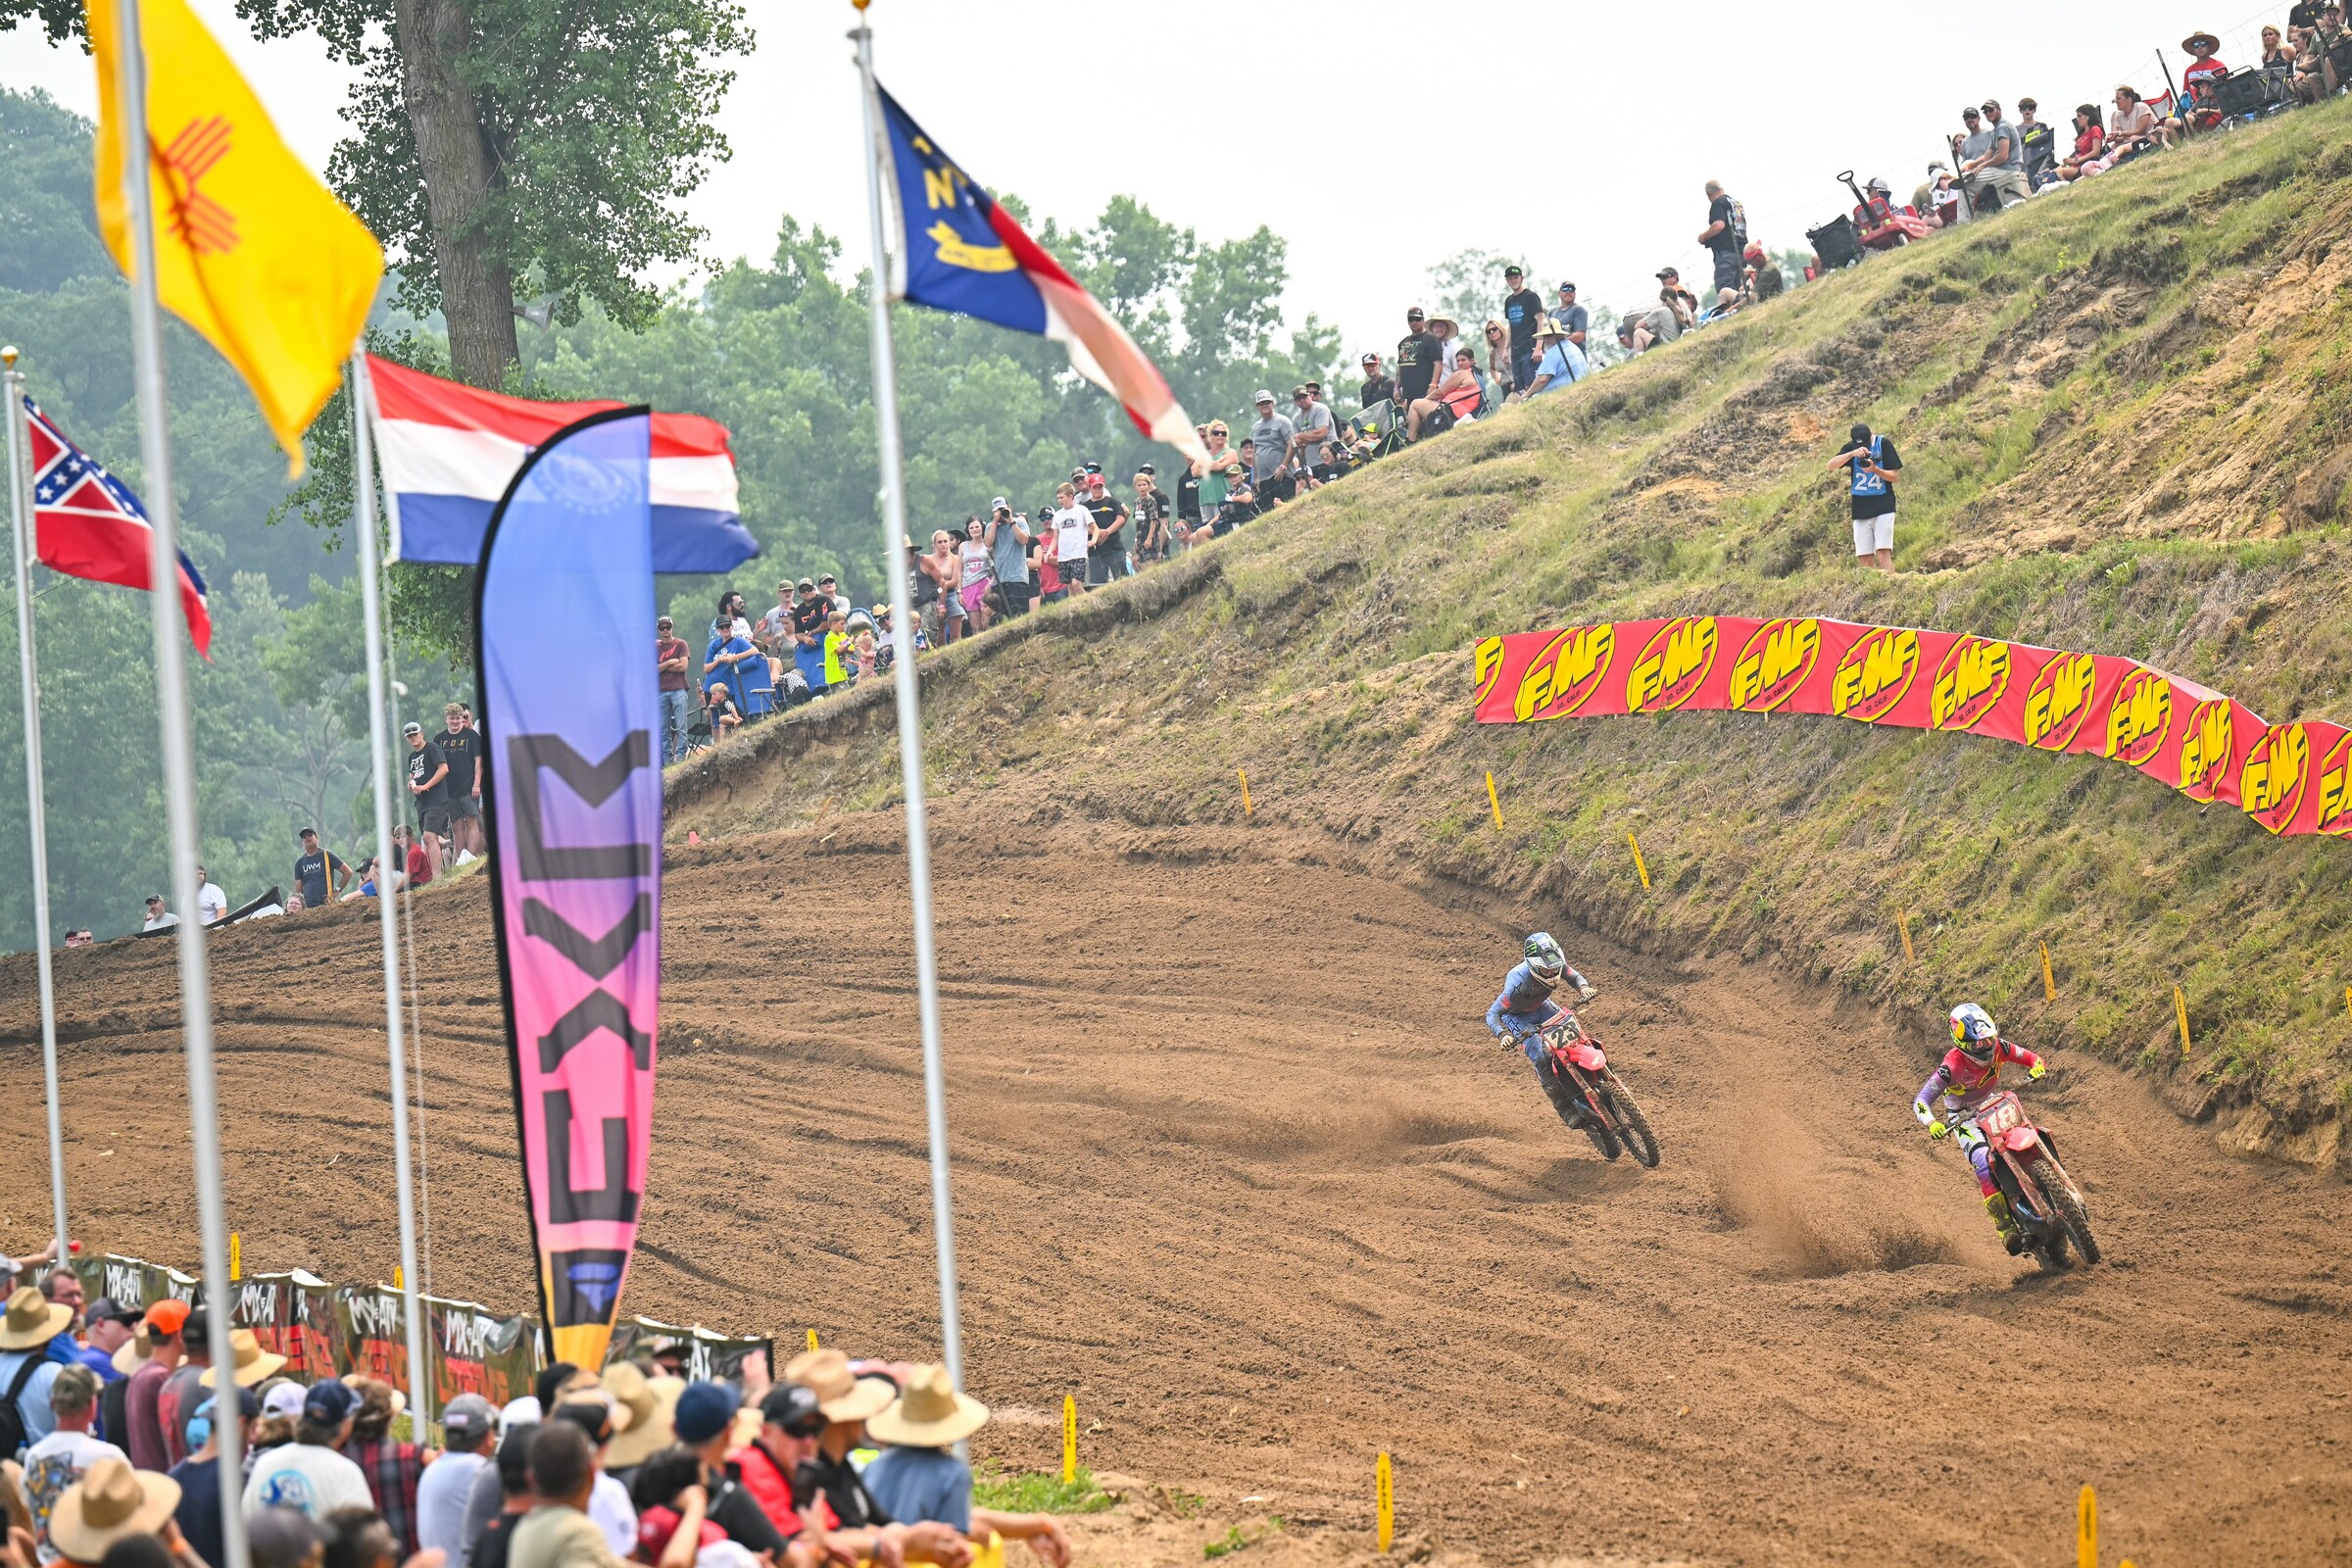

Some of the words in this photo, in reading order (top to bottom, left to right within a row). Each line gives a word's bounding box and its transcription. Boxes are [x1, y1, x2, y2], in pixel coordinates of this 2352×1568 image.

[1854, 472, 1883, 491] 24
[1516, 623, 1613, 723] FMF
[1628, 616, 1715, 713] FMF
[1733, 618, 1818, 710] FMF
[1834, 629, 1917, 716] FMF
[1934, 639, 2009, 730] FMF
[2027, 654, 2093, 747] FMF
[442, 739, 466, 748] FOX
[2104, 673, 2170, 760] FMF
[2175, 699, 2231, 790] FMF
[410, 757, 424, 772] FOX
[2242, 723, 2306, 815] FMF
[302, 861, 321, 873] UWM
[508, 729, 651, 1225] FXR
[1550, 1020, 1580, 1051] 23
[1987, 1102, 2017, 1137] 18
